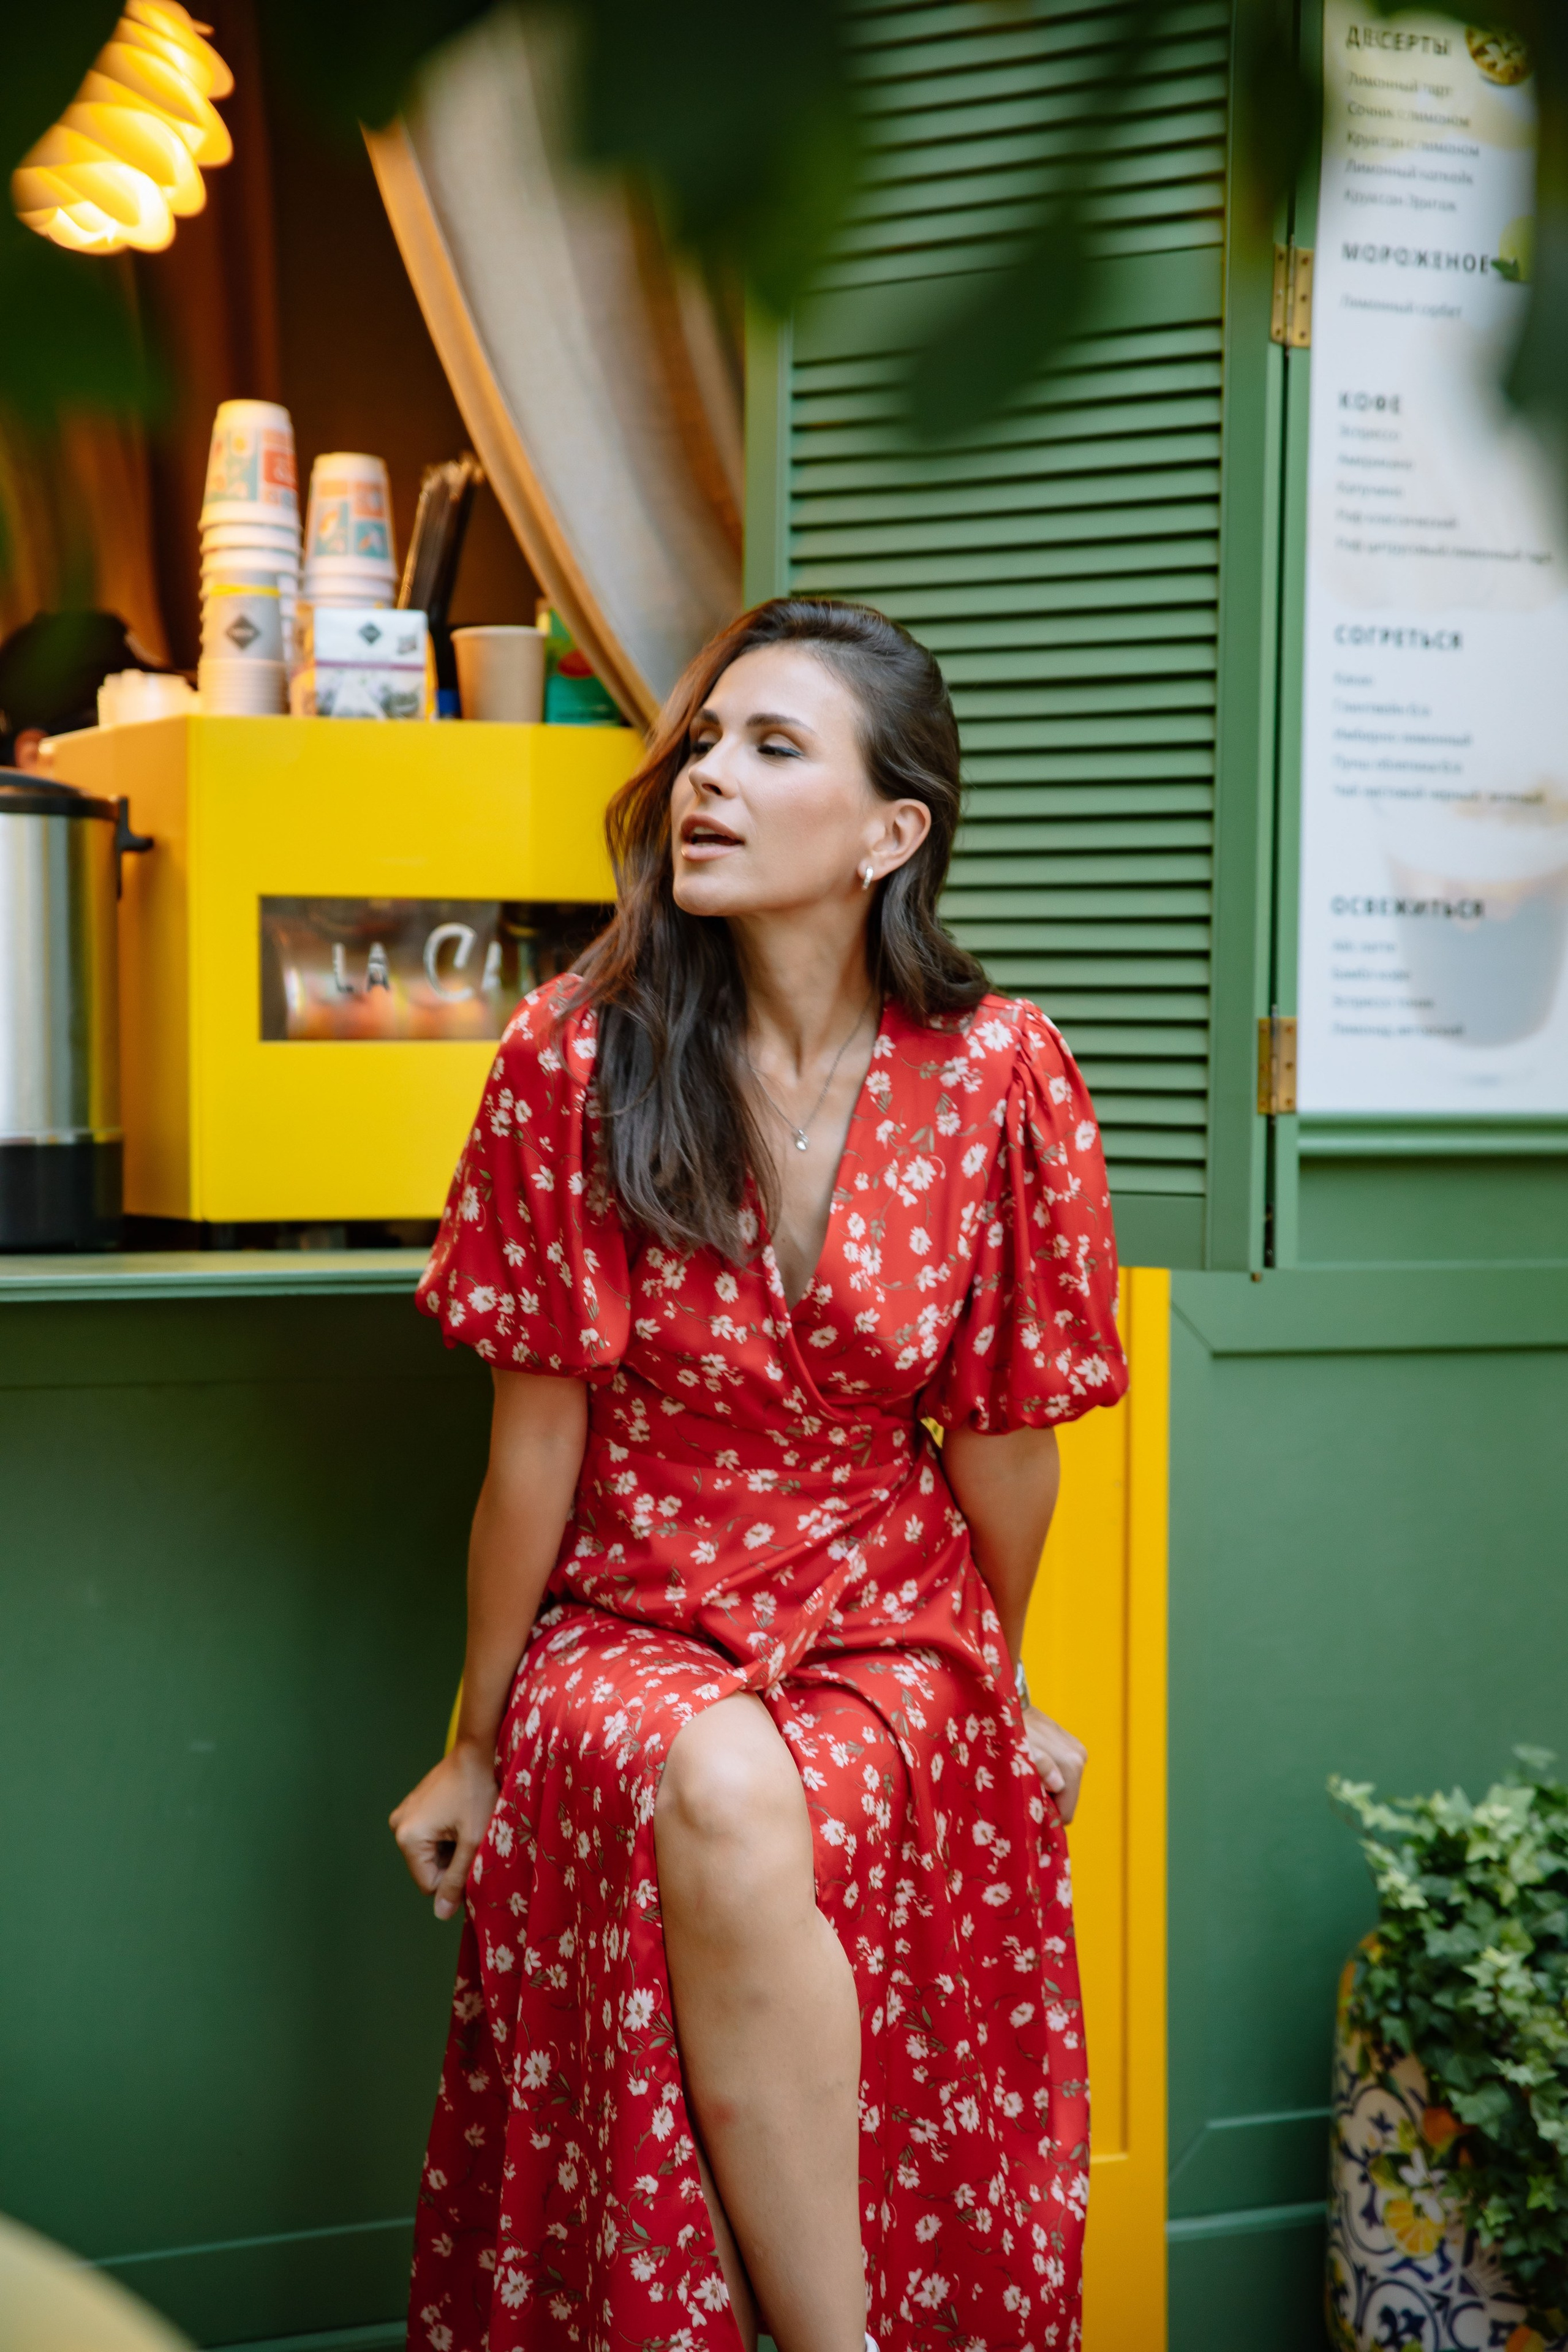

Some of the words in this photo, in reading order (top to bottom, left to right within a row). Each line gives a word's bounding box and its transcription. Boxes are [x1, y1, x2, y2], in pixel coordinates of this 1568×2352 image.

[1346, 23, 1451, 56] ДЕСЕРТЫ
[1342, 241, 1490, 274] МОРОЖЕНОЕ
[1340, 392, 1400, 414] КОФЕ
